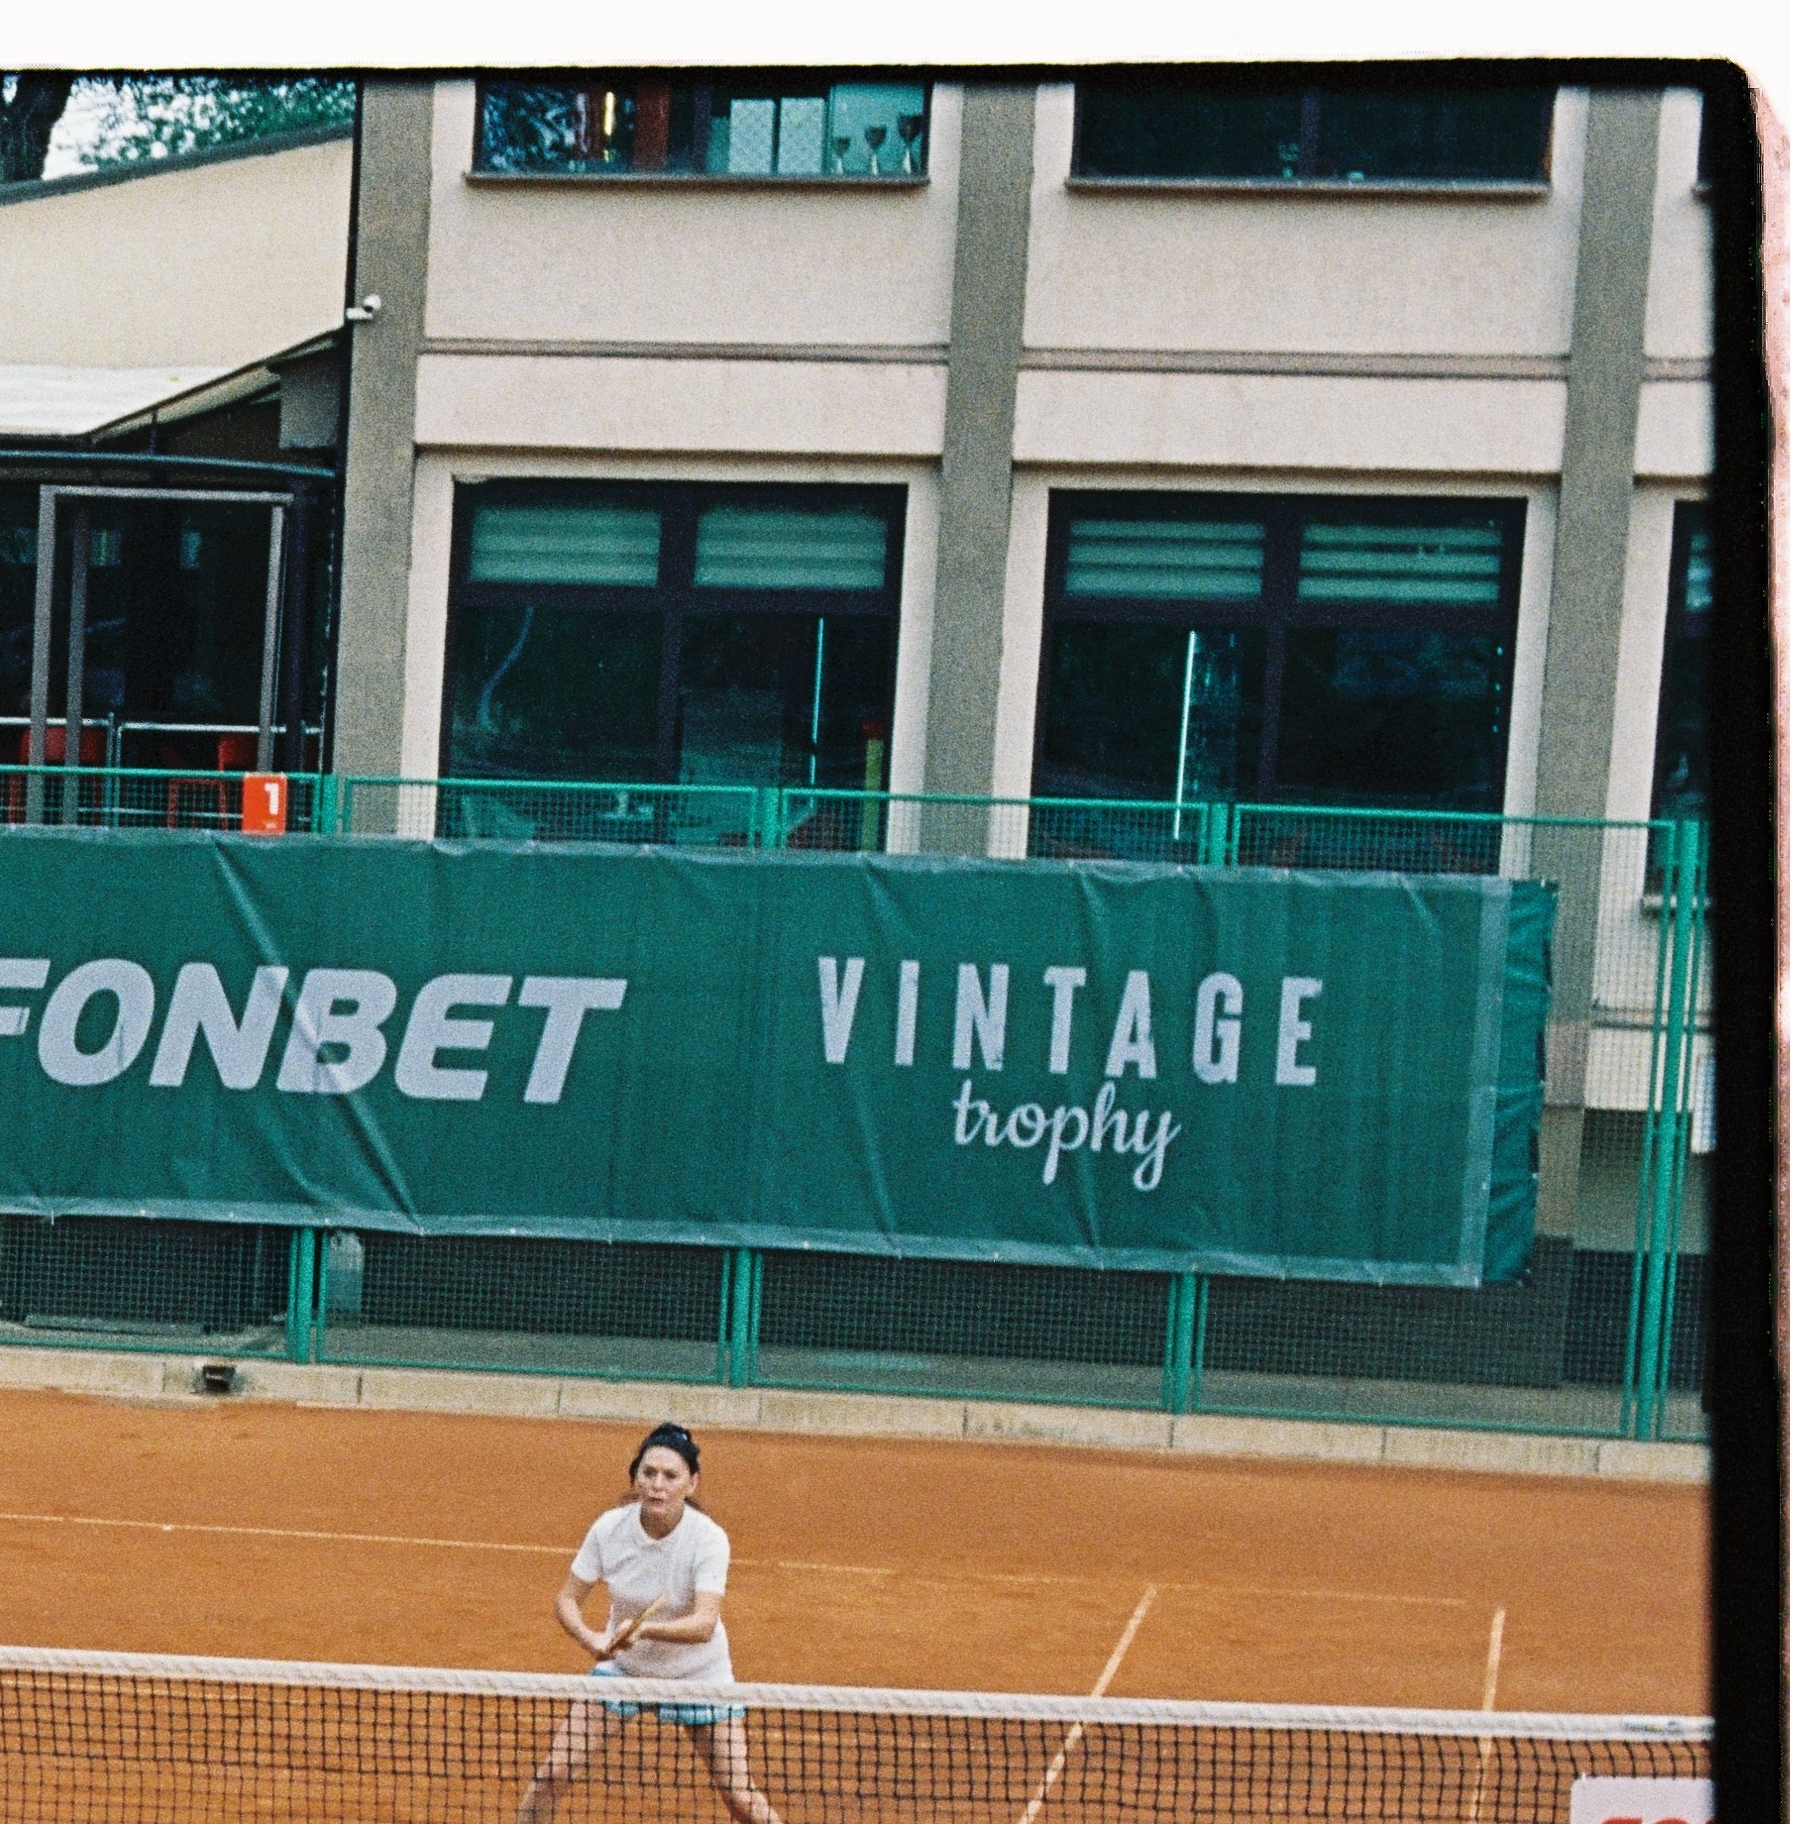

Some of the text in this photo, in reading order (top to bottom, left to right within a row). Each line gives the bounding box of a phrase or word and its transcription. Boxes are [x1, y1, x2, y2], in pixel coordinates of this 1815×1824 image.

[264, 782, 280, 816] 1
[818, 956, 1323, 1086] VINTAGE
[952, 1079, 1181, 1191] trophy
